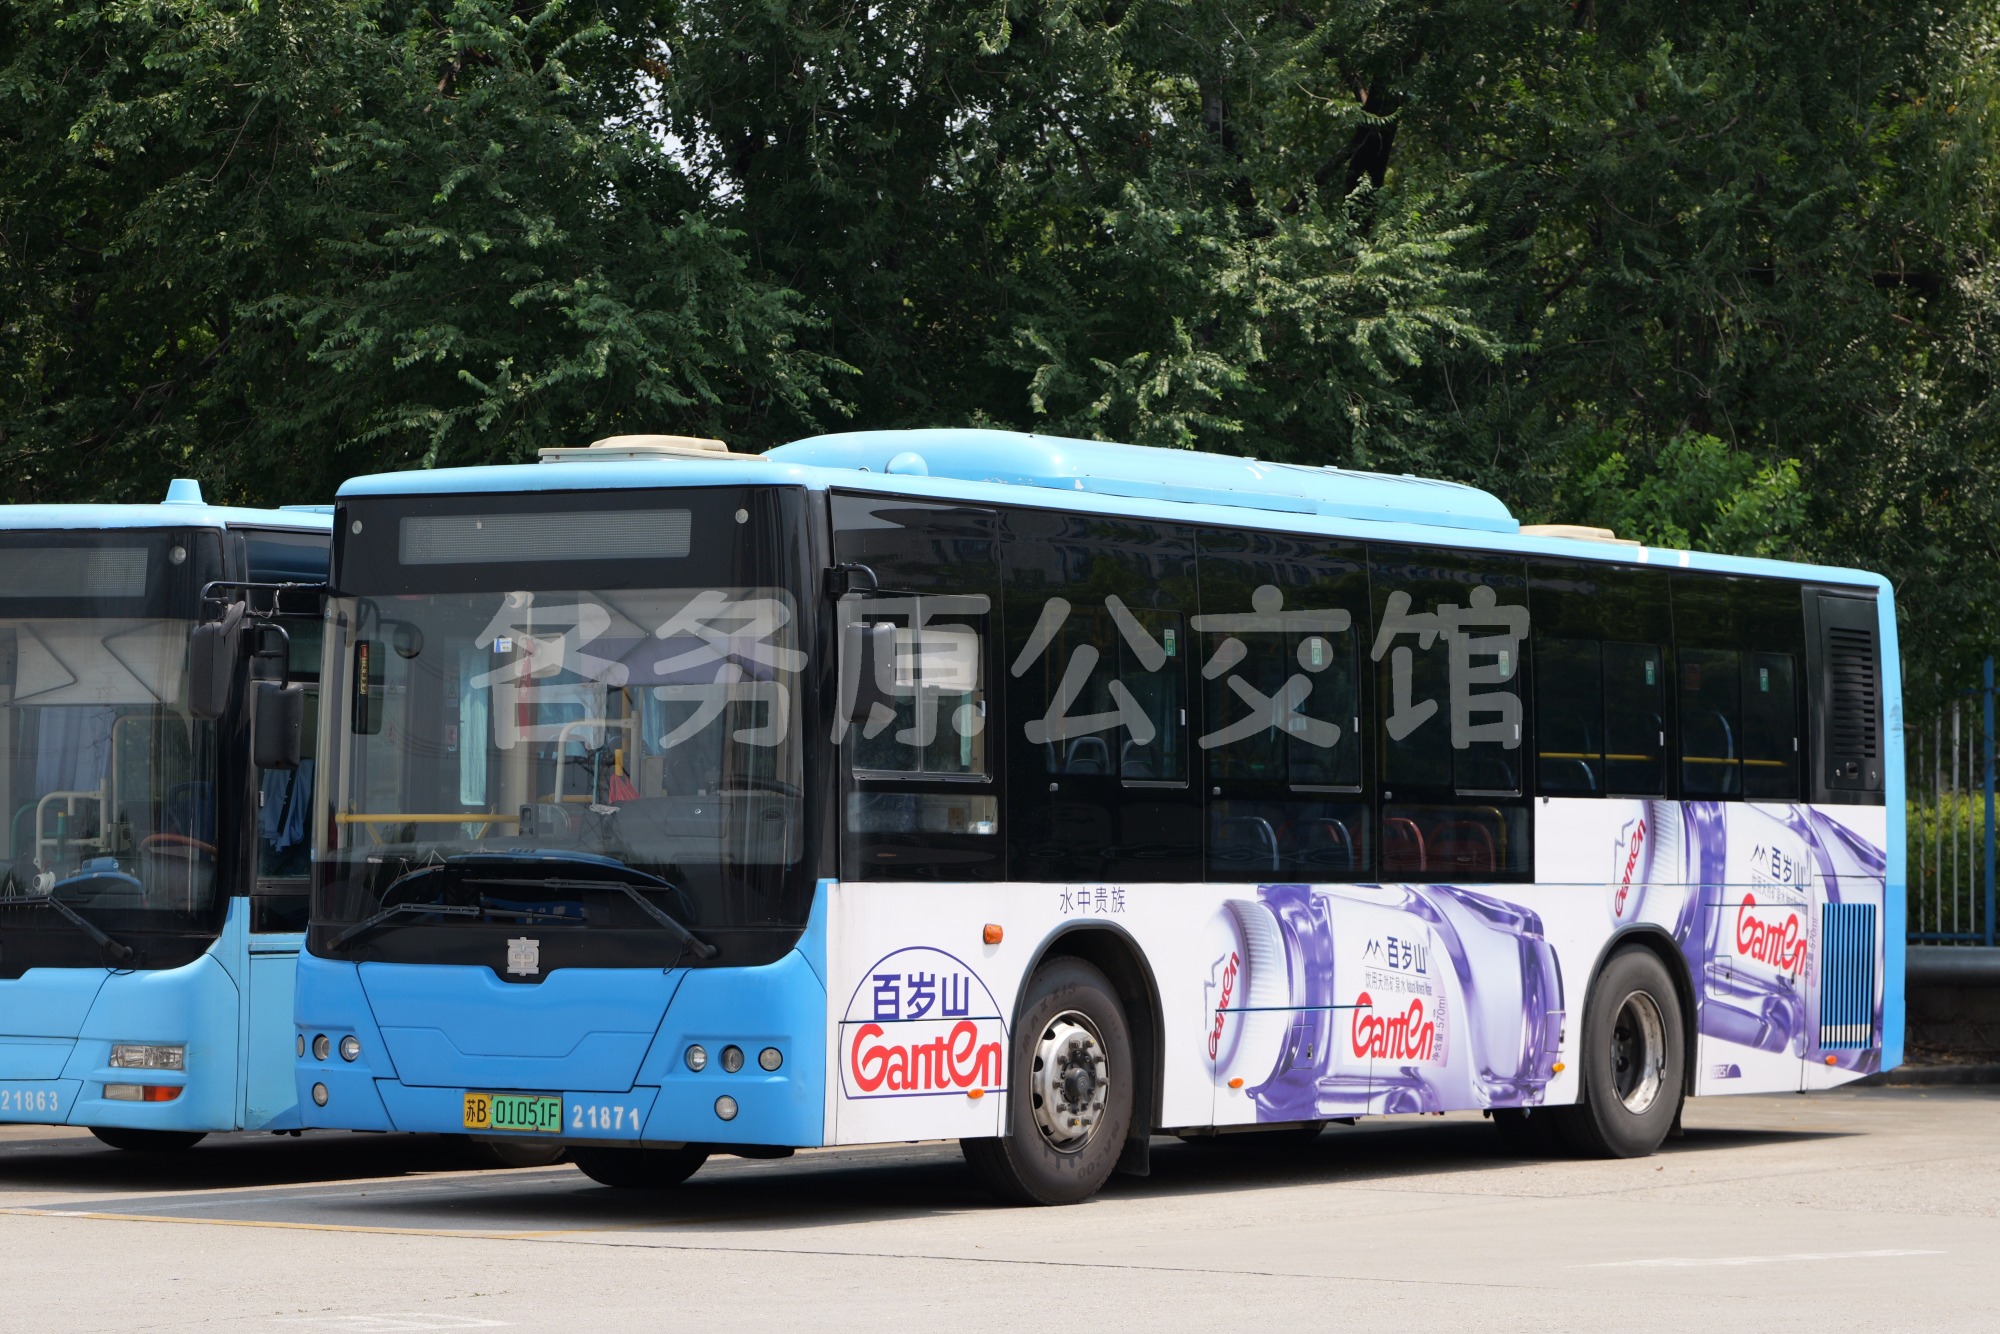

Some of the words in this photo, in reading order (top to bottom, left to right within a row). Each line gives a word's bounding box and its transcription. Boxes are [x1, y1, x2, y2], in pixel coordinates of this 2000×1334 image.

[1772, 846, 1803, 893] 百岁山
[1059, 886, 1125, 914] 水中贵族
[1386, 936, 1426, 974] 百岁山
[1737, 893, 1806, 976] Ganten
[872, 971, 969, 1021] 百岁山
[1352, 991, 1434, 1061] Ganten
[851, 1020, 1002, 1092] Ganten
[1, 1089, 59, 1112] 21863
[572, 1104, 640, 1131] 21871
